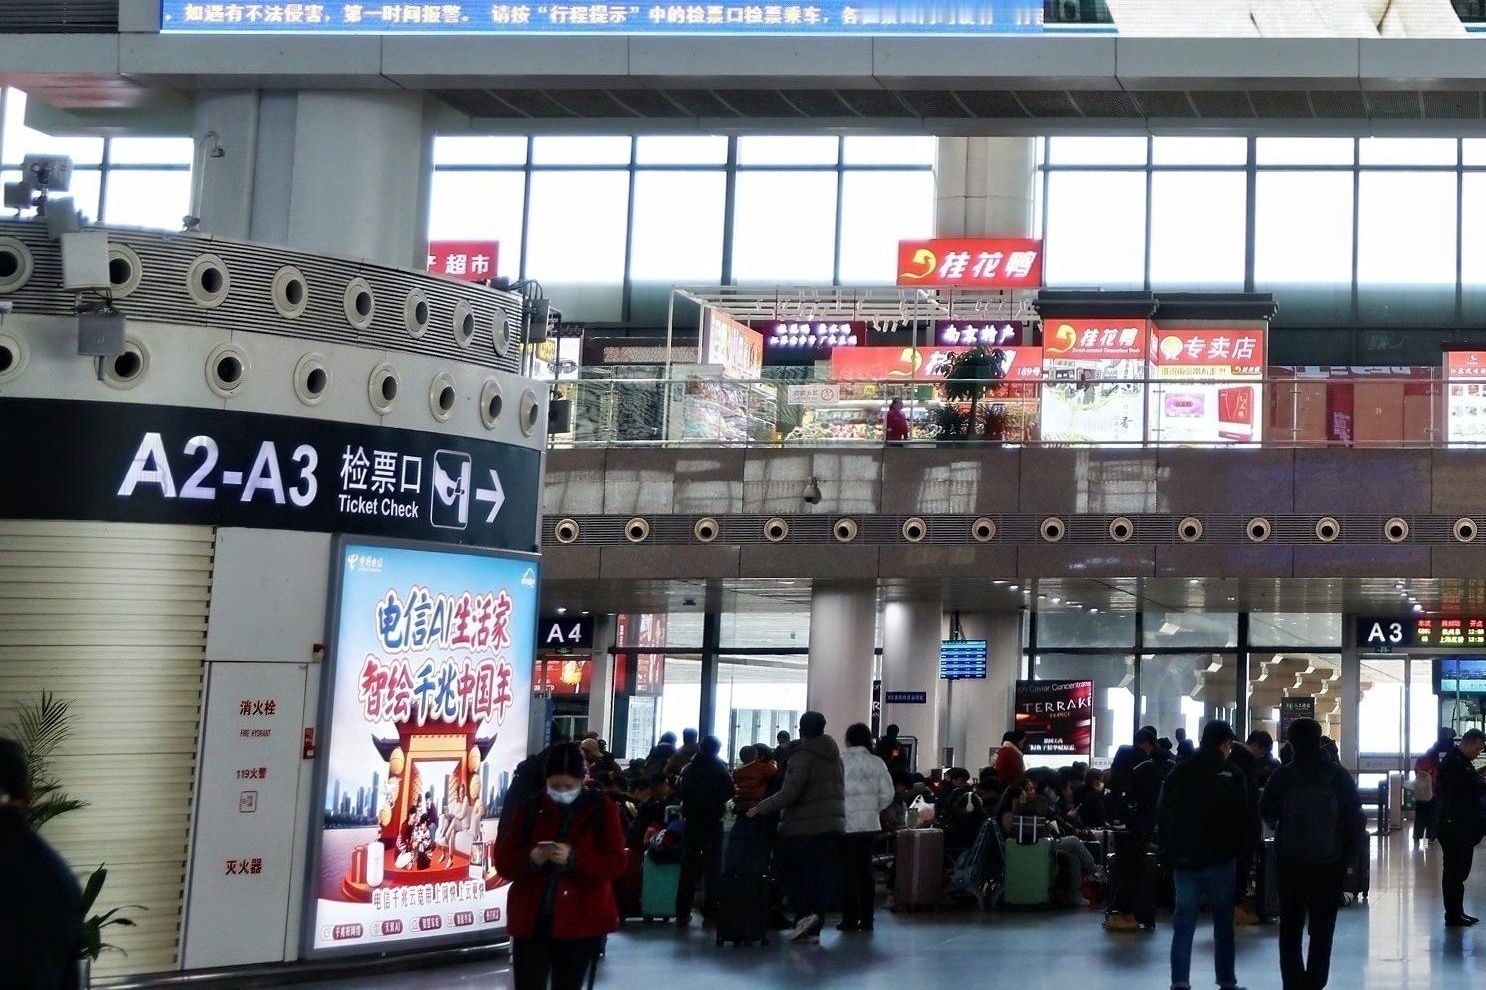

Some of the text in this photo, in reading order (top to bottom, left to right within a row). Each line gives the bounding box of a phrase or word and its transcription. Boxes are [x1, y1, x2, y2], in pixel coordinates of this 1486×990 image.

[938, 250, 1037, 279] 桂花鸭
[1080, 327, 1139, 347] 桂花鸭
[1184, 336, 1257, 360] 专卖店
[116, 432, 319, 508] A2-A3
[339, 444, 423, 495] 检票口
[338, 494, 420, 520] Ticket Check
[378, 589, 512, 652] 电信AI生活家
[360, 658, 513, 724] 智绘千兆中国年
[240, 700, 276, 716] 消火栓
[225, 858, 262, 876] 灭火器
